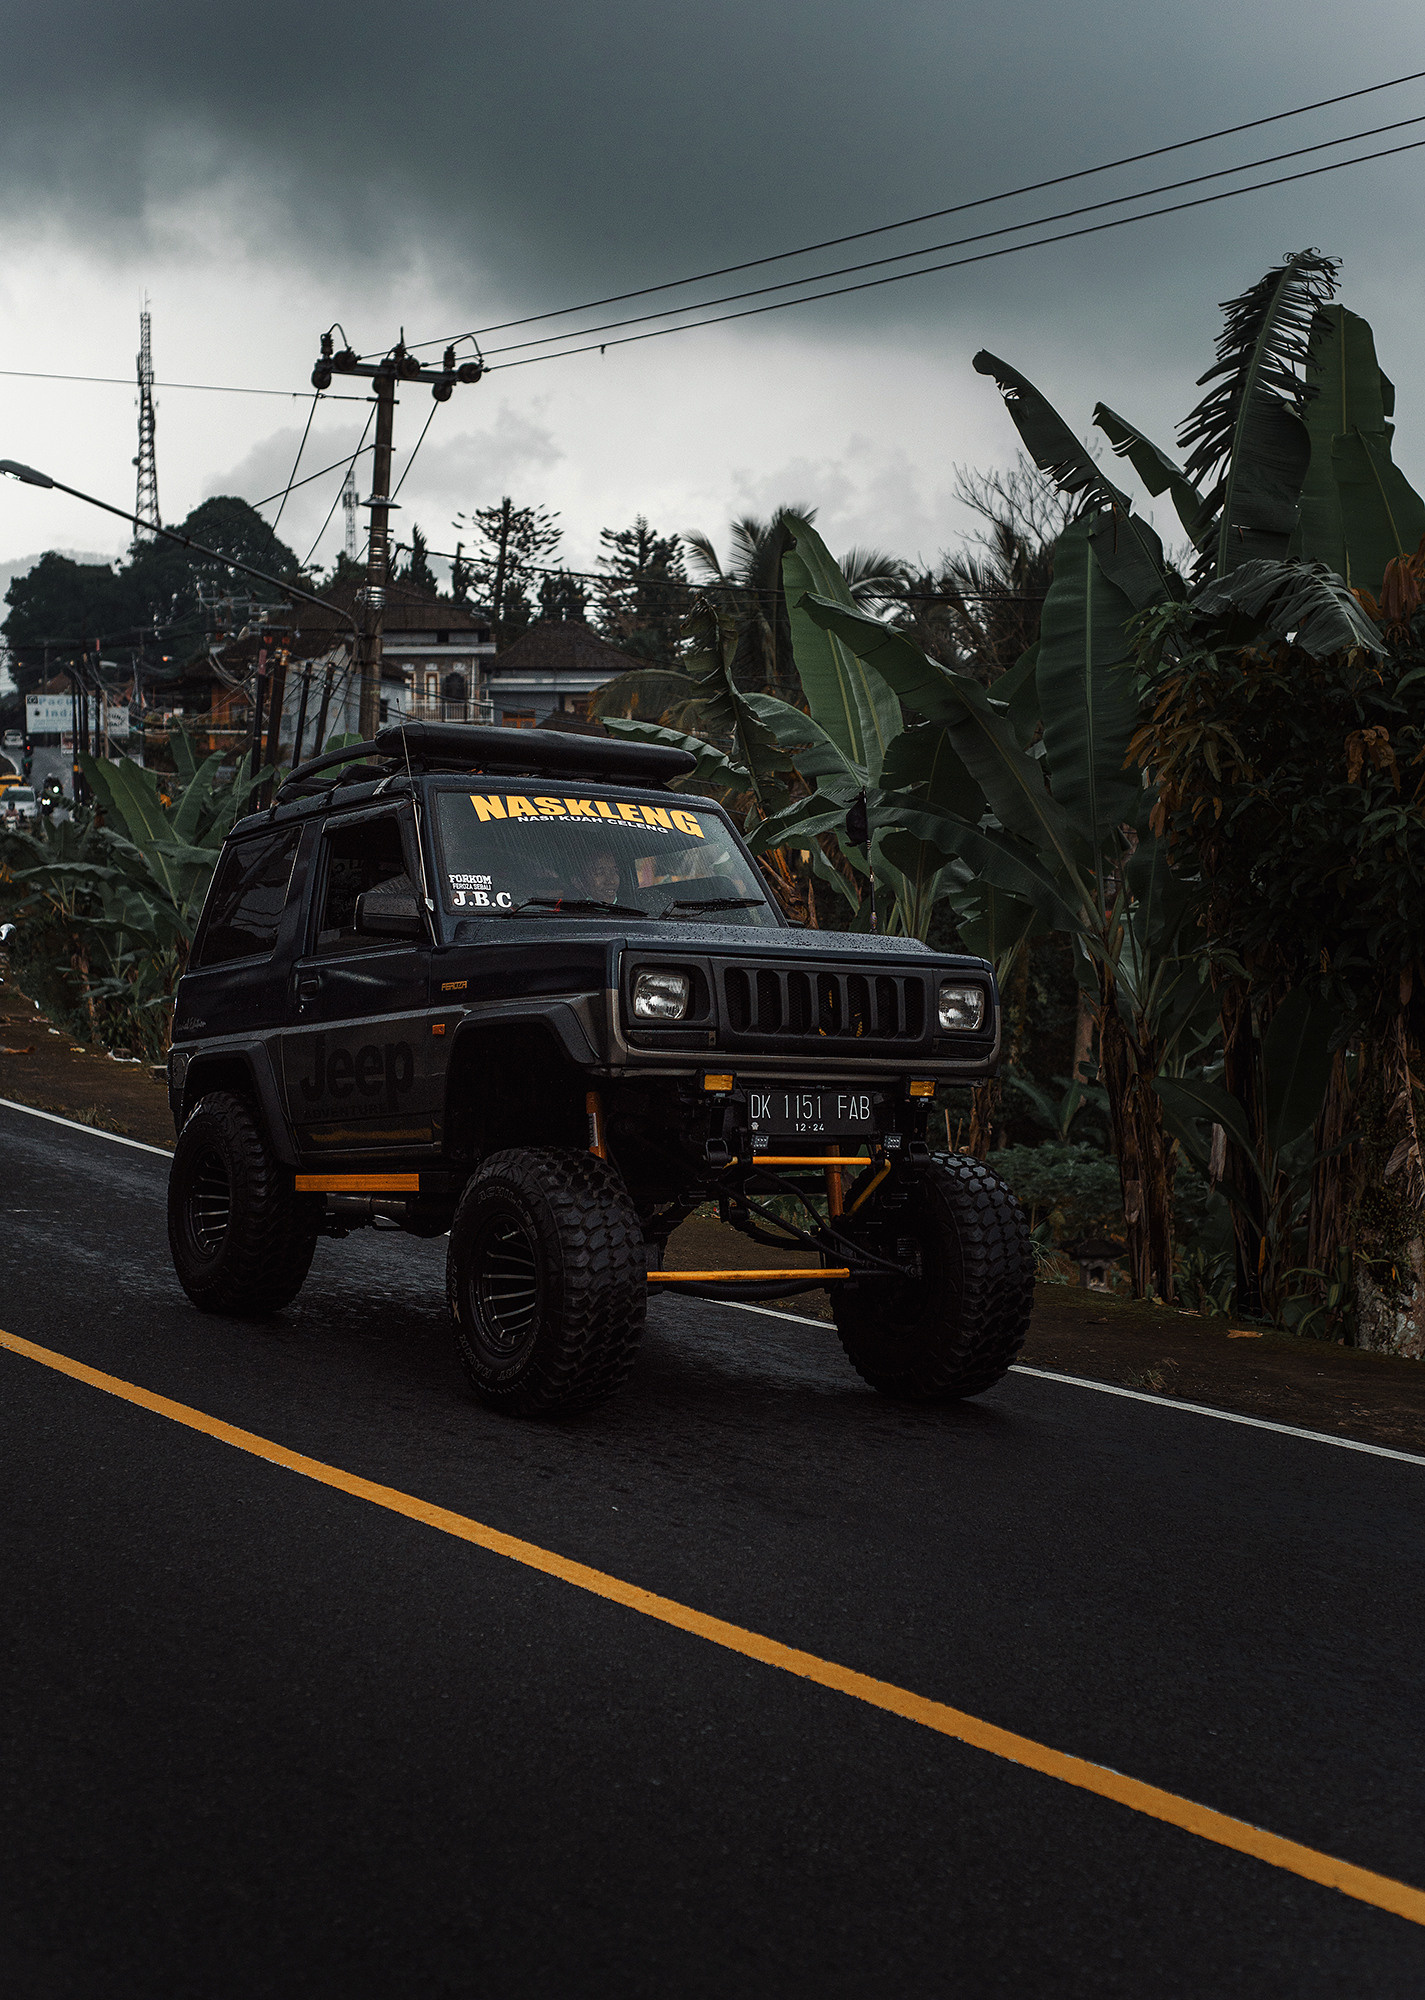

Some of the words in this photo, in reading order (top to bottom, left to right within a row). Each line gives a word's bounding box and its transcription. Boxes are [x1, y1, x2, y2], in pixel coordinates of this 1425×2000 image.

[470, 795, 704, 838] NASKLENG
[517, 815, 554, 823] NASI
[559, 815, 603, 824] KUAH
[607, 819, 668, 833] CELENG
[448, 874, 492, 884] FORKOM
[454, 891, 512, 908] J.B.C
[299, 1034, 414, 1112] Jeep
[751, 1094, 771, 1119] DK
[785, 1095, 822, 1119] 1151
[838, 1095, 871, 1120] FAB
